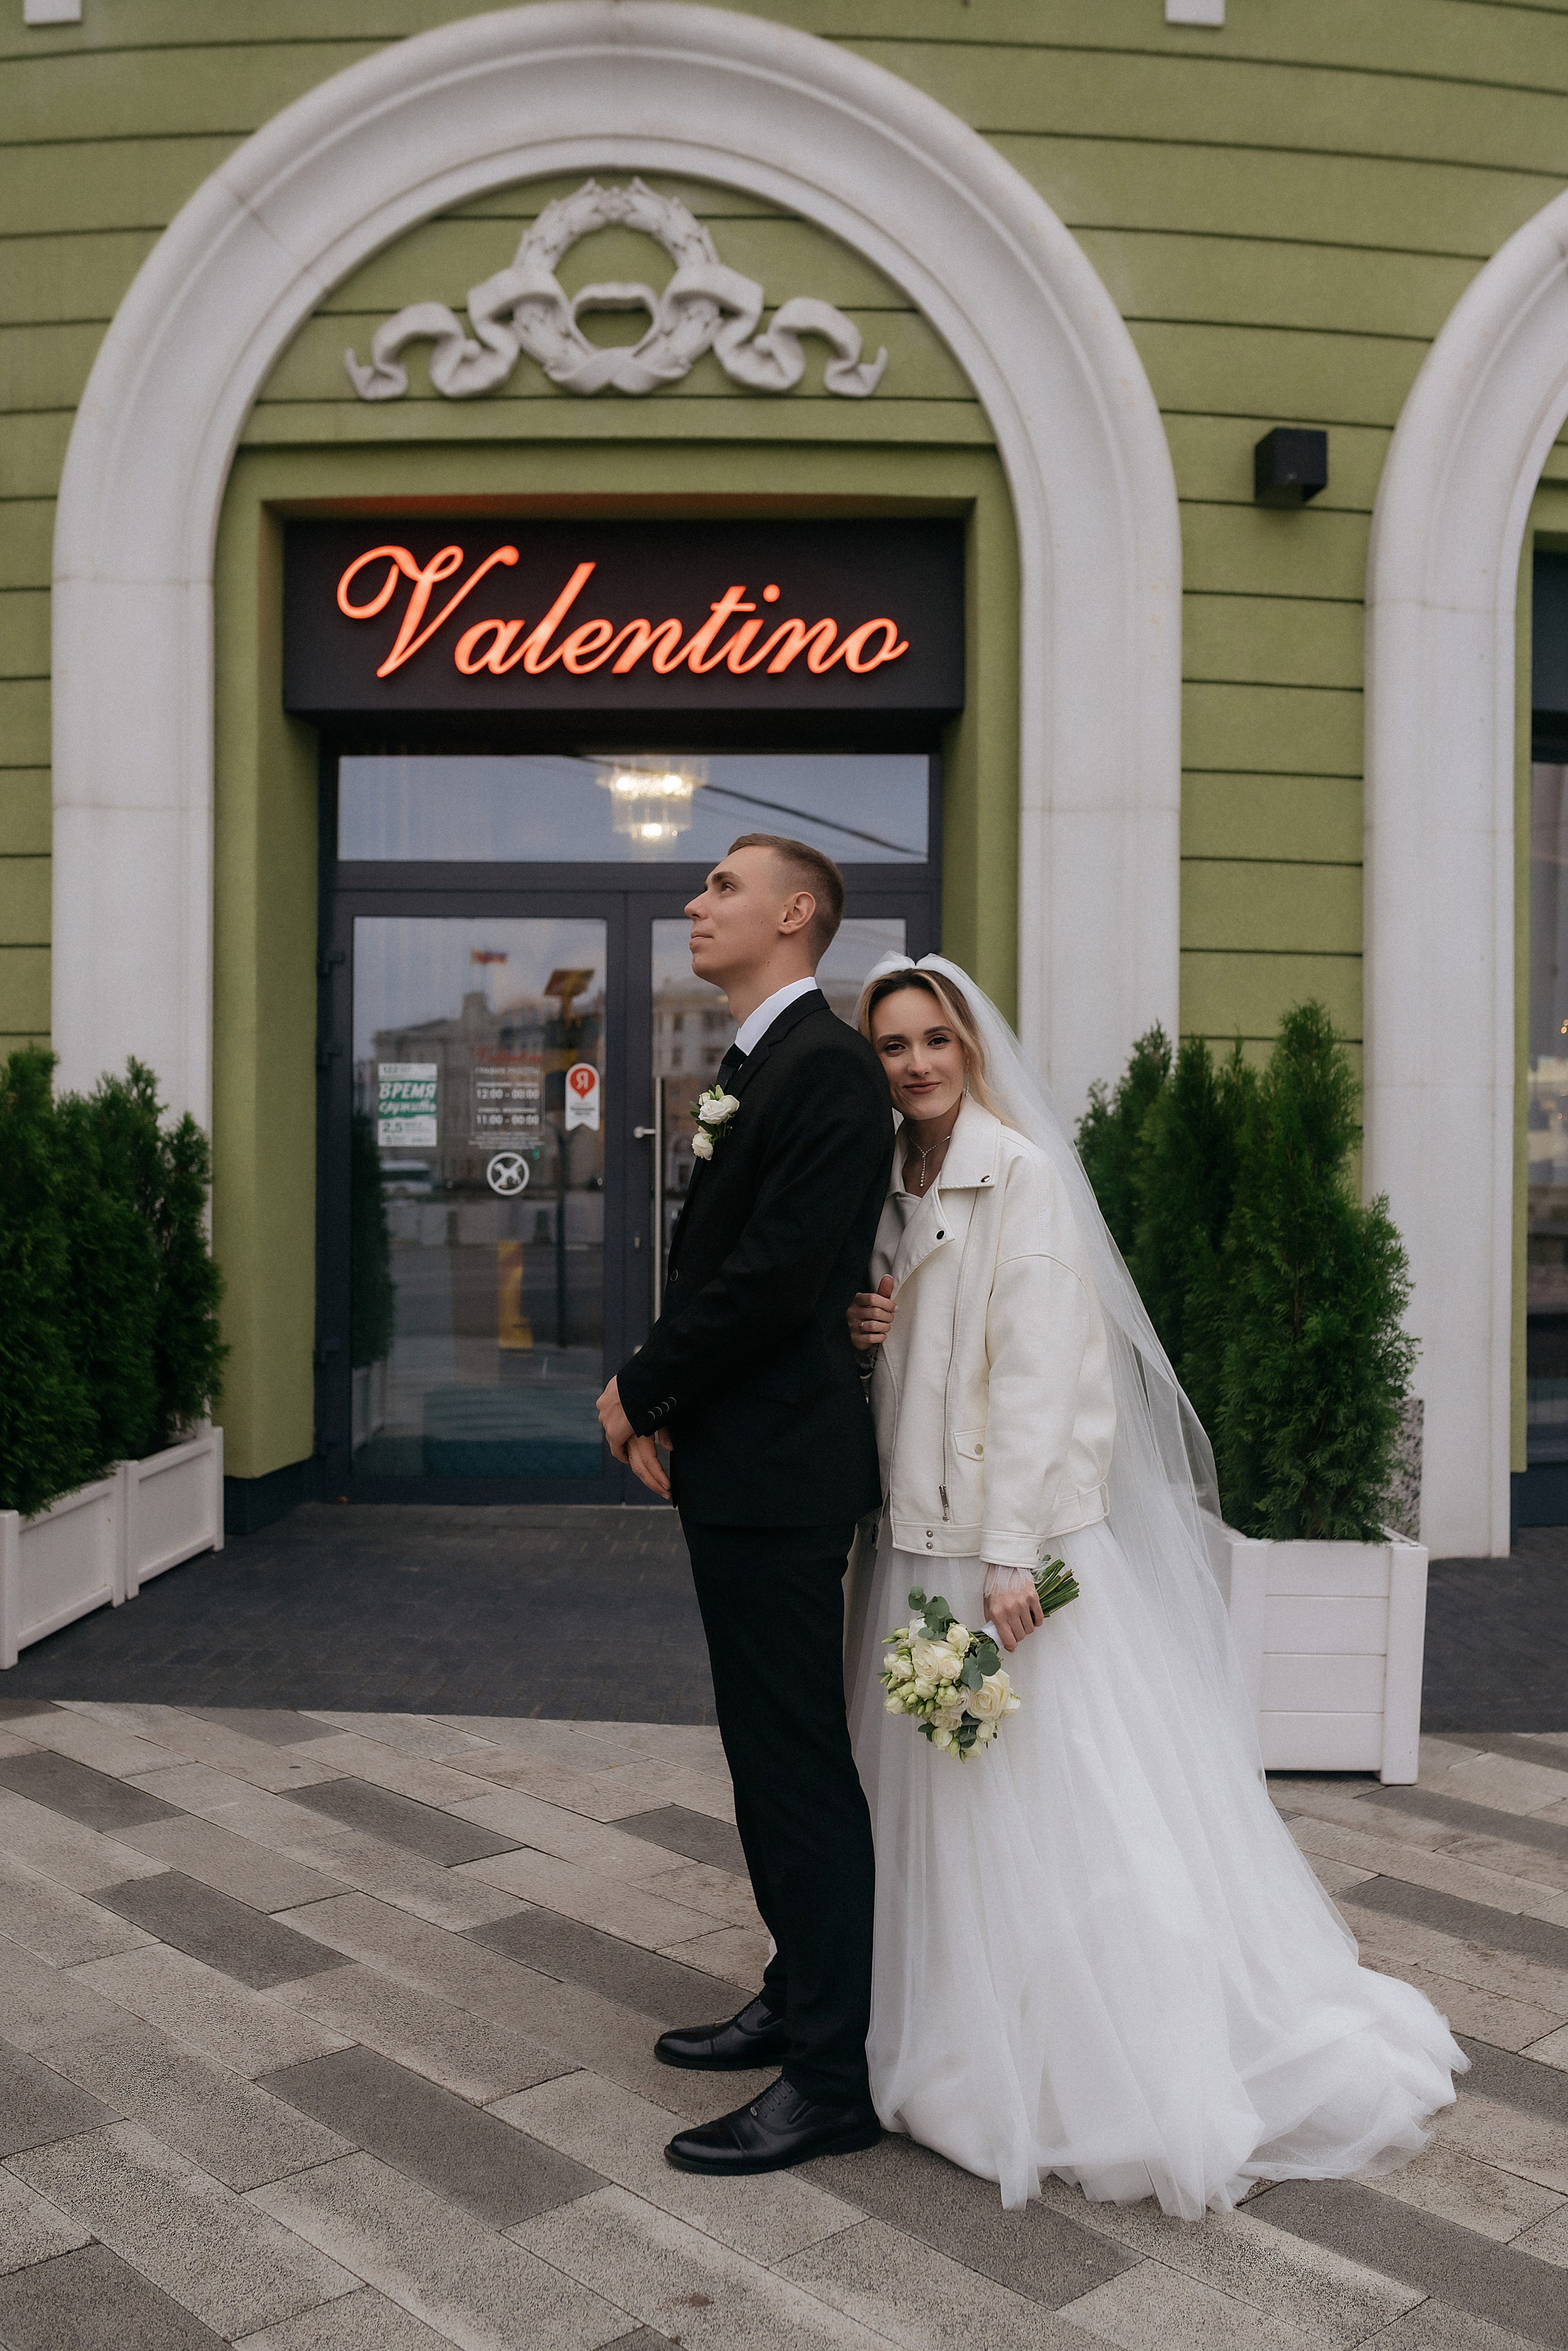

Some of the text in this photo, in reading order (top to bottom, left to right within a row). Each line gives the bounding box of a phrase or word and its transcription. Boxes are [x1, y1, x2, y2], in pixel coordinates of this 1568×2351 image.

[337, 545, 910, 677] Valentino
[576, 1071, 589, 1090] Я
[379, 1082, 437, 1100] ВРЕМЯ
[476, 1089, 503, 1100] 12:00
[476, 1114, 503, 1125] 11:00
